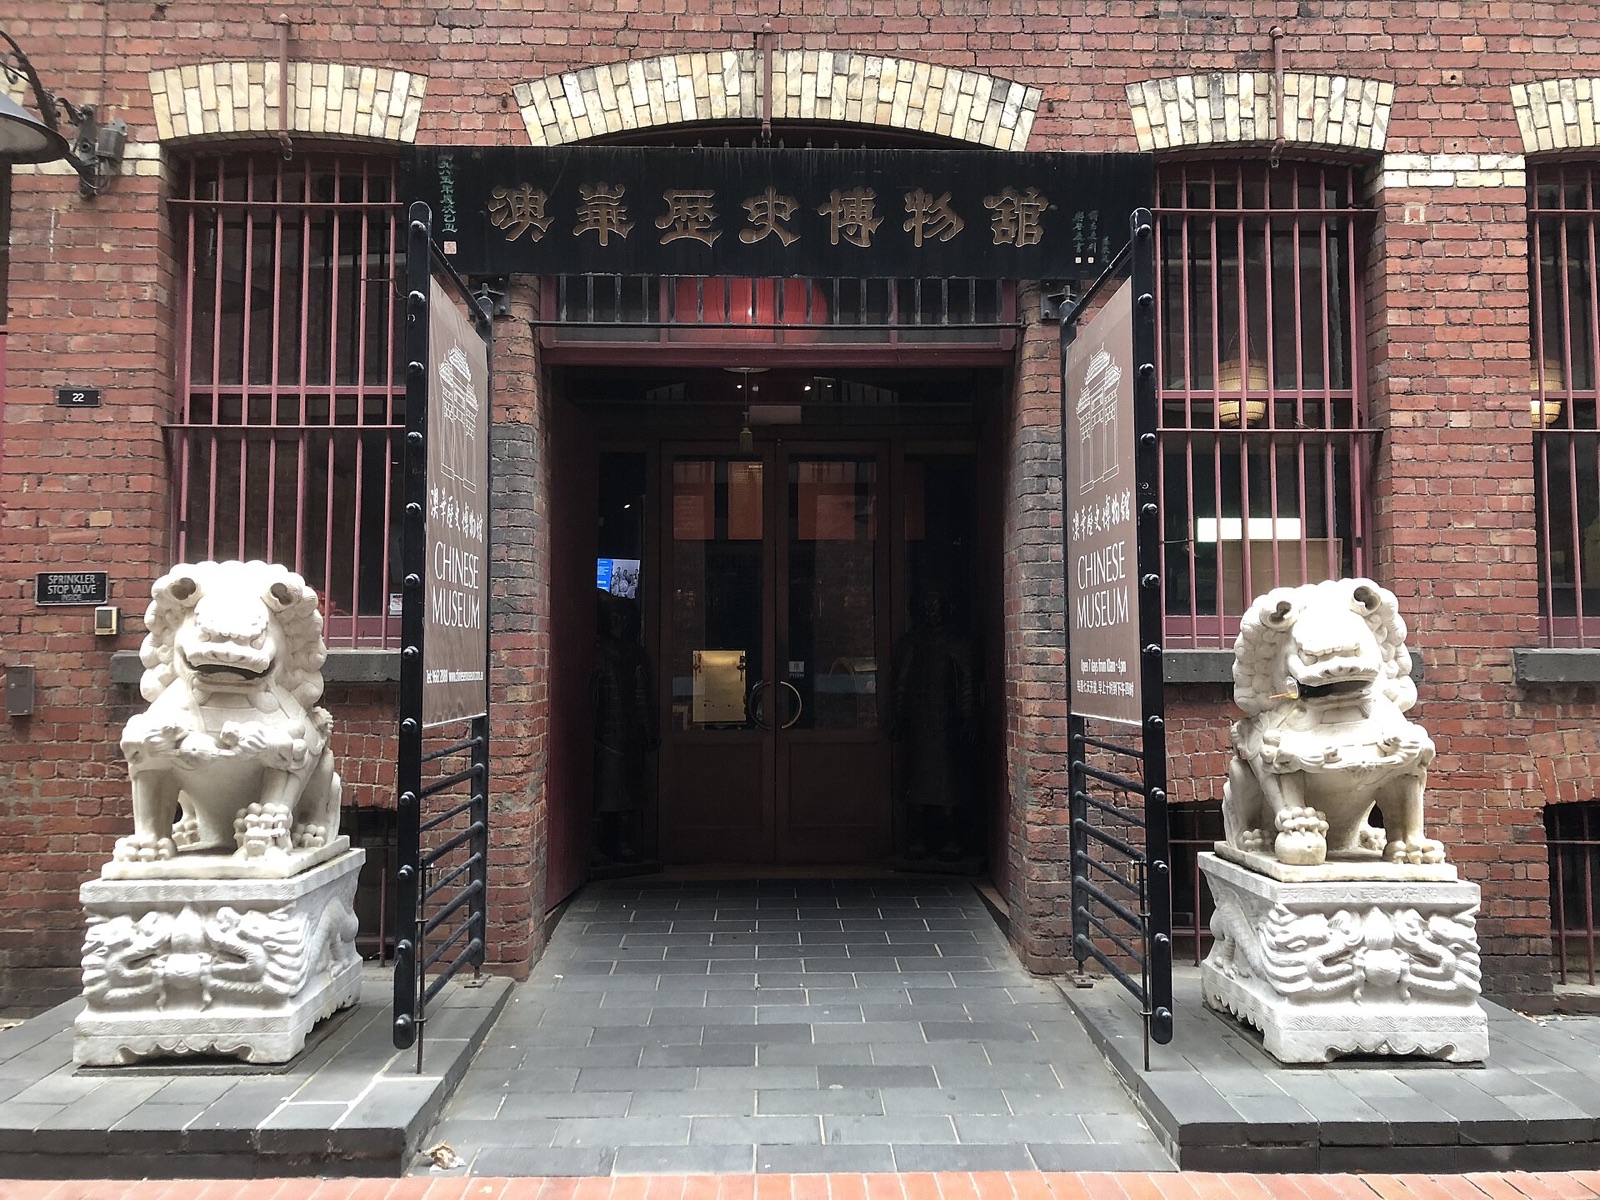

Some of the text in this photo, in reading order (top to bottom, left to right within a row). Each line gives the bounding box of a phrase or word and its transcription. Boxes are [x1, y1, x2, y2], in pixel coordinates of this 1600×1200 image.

[72, 393, 85, 402] 22
[48, 574, 96, 585] SPRINKLER
[434, 541, 479, 590] CHINESE
[1077, 541, 1126, 590] CHINESE
[47, 584, 97, 595] STOP VALVE
[432, 585, 481, 630] MUSEUM
[1077, 585, 1129, 630] MUSEUM
